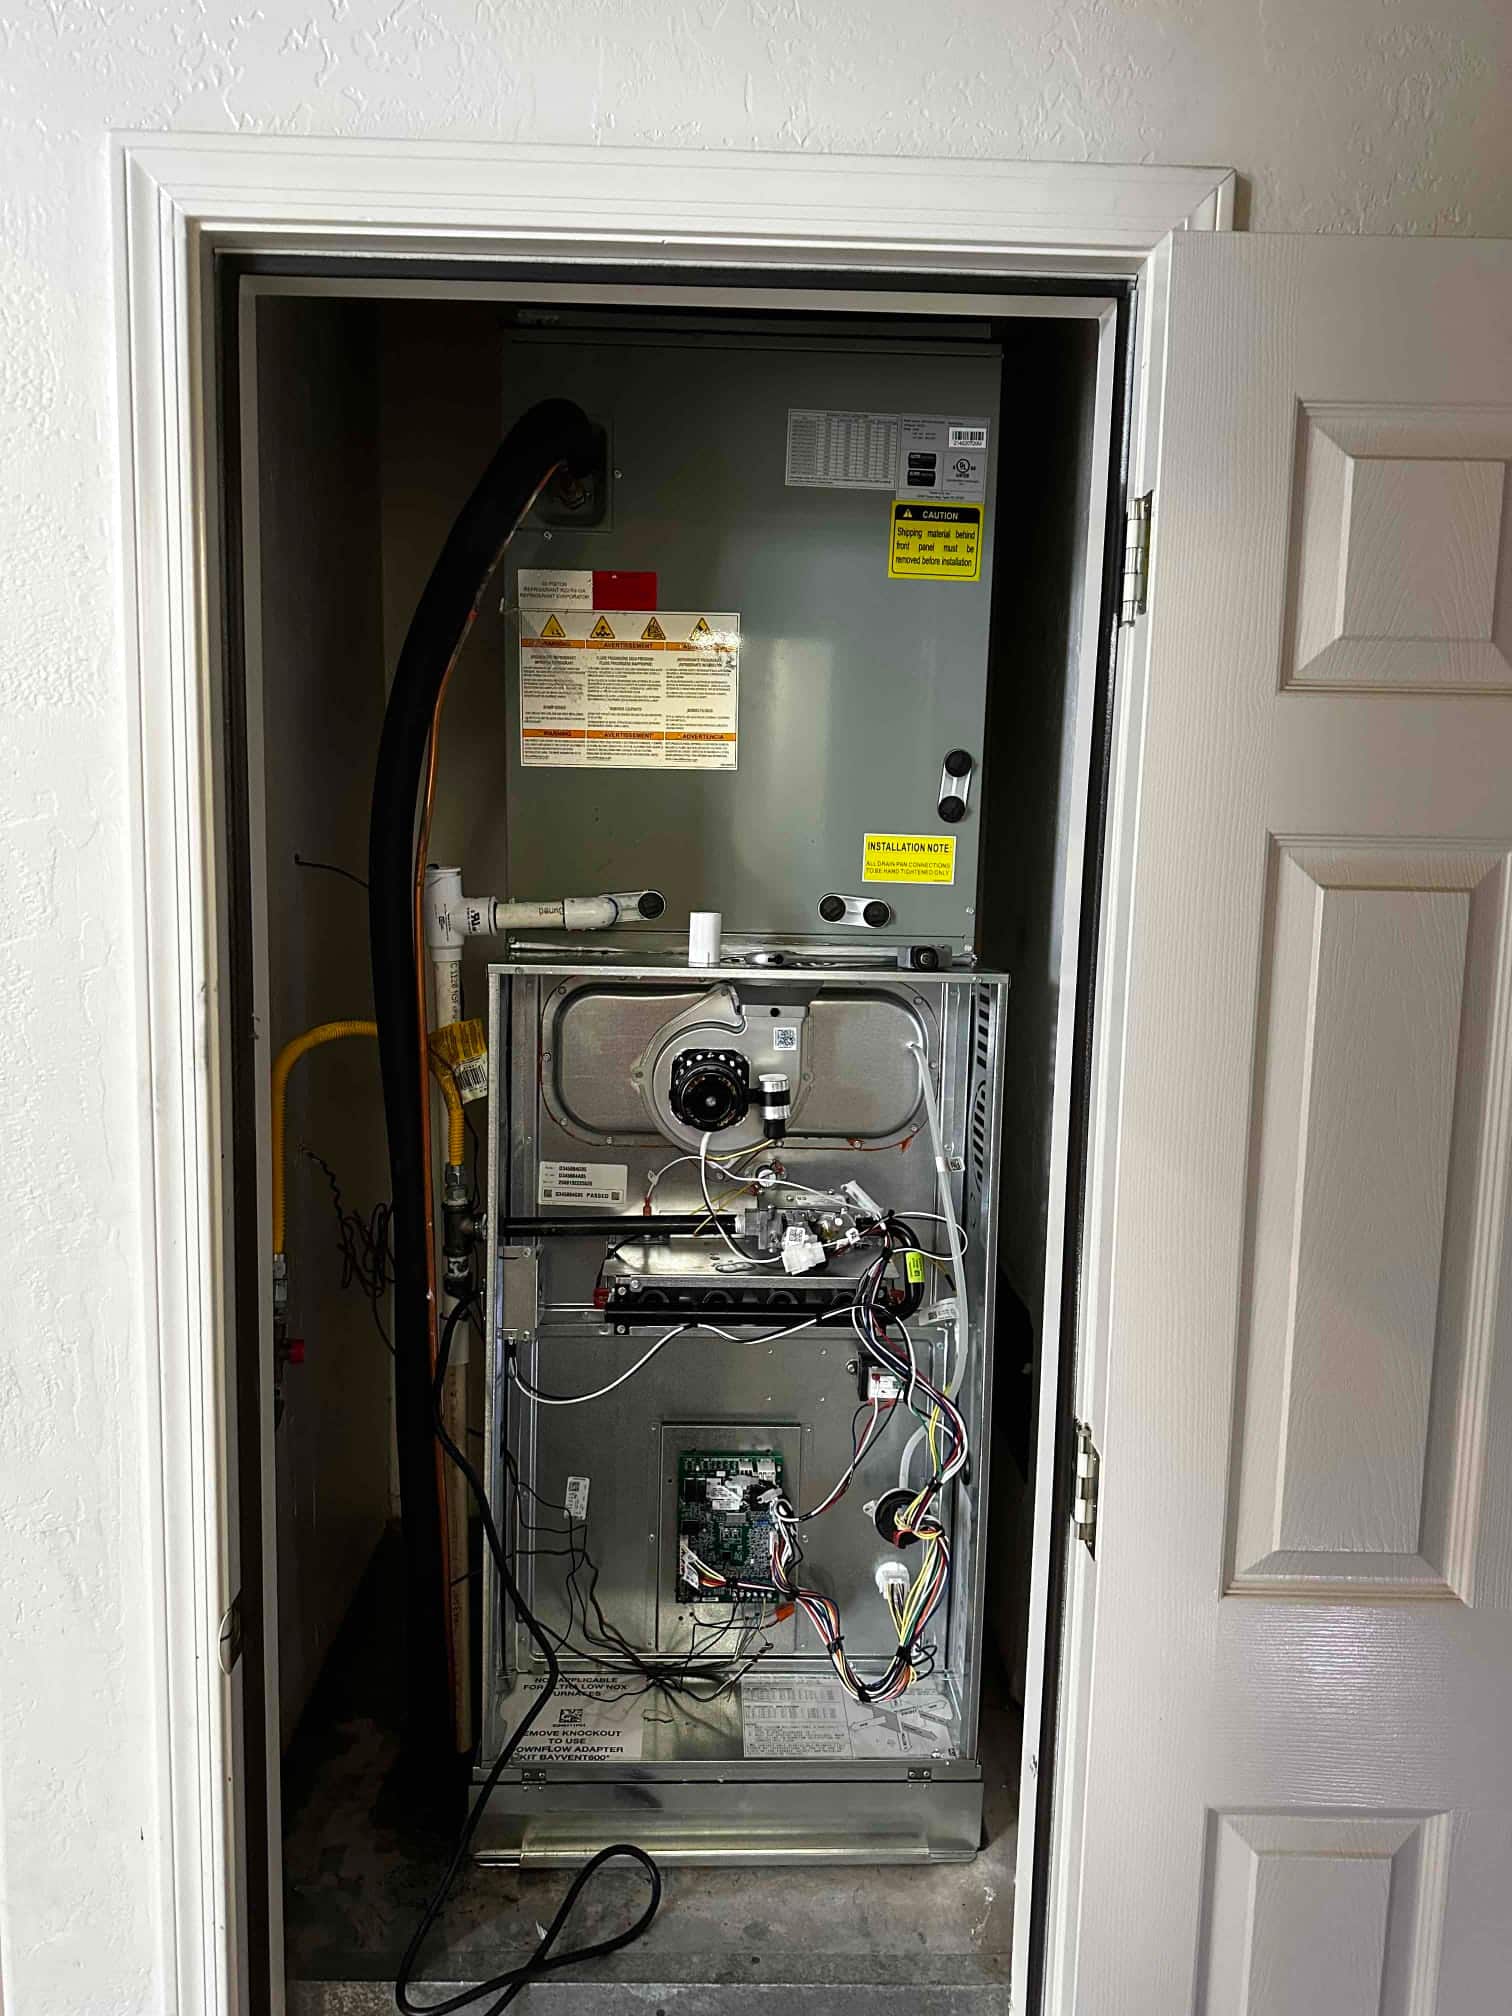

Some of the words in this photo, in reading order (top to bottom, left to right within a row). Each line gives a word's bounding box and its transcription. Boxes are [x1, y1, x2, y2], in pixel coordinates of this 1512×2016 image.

[922, 510, 959, 520] CAUTION
[897, 527, 923, 539] Shipping
[927, 529, 951, 538] material
[955, 529, 976, 539] behind
[896, 541, 910, 550] front
[918, 543, 935, 552] panel
[943, 544, 957, 552] must
[966, 544, 974, 553] be
[896, 556, 921, 564] removed
[921, 556, 940, 565] before
[941, 557, 972, 567] installation
[867, 841, 926, 852] INSTALLATION
[927, 844, 949, 853] NOTE
[516, 1745, 573, 1753] OWNFLOW
